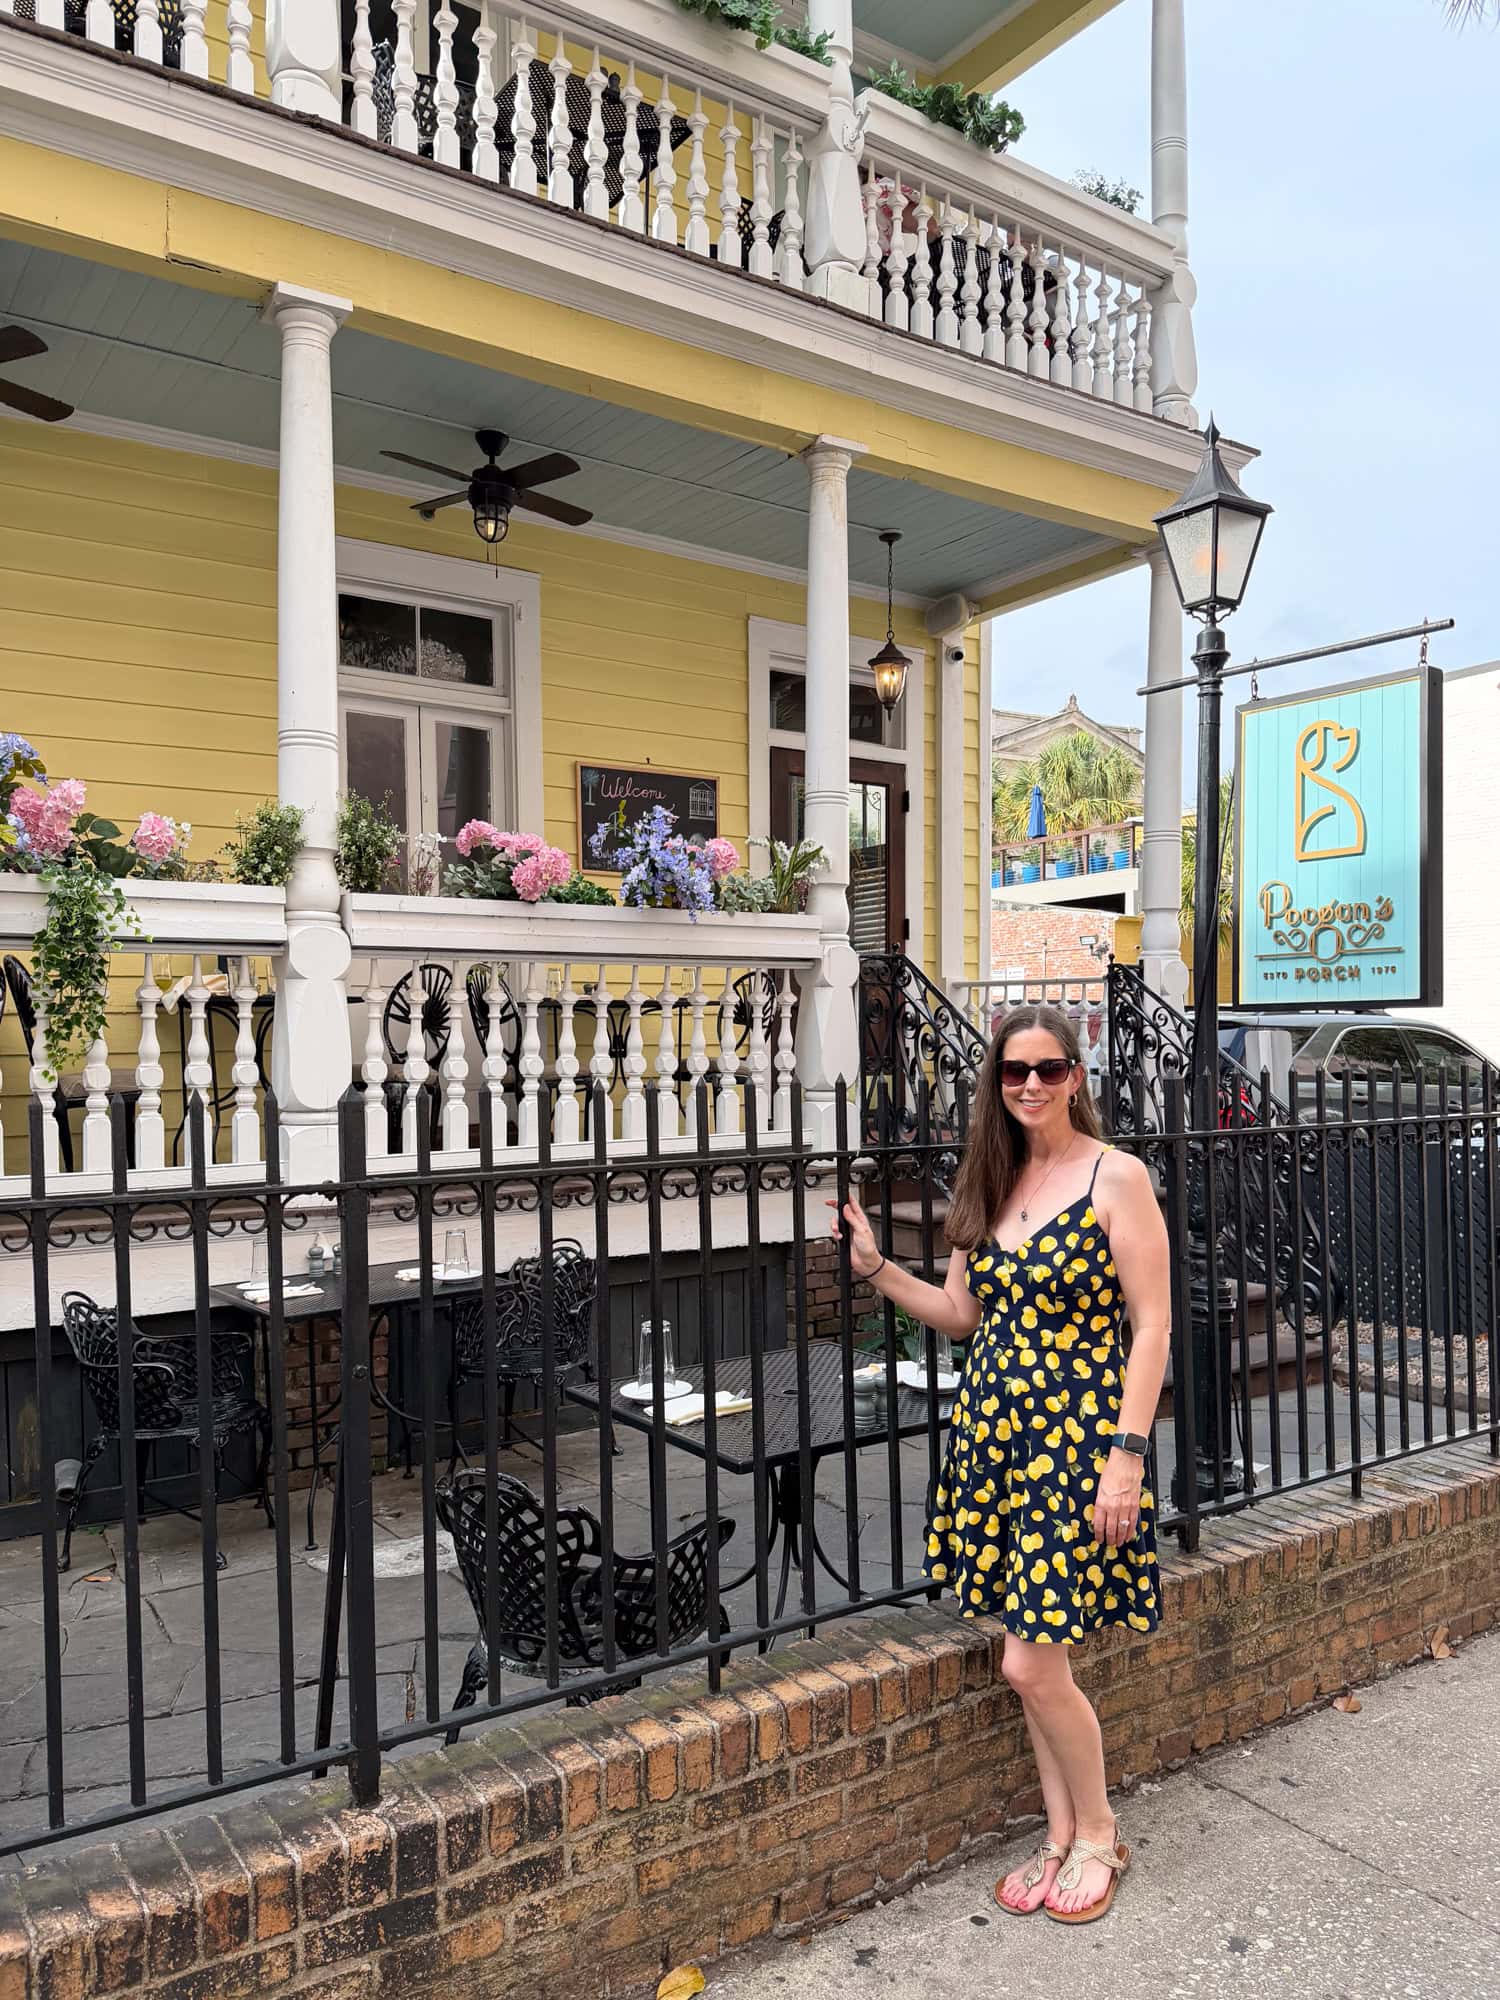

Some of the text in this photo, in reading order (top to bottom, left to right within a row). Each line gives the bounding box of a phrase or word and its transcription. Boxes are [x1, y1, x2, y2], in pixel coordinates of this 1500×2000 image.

[600, 773, 667, 800] Welcome
[1258, 880, 1395, 937] Poogan's
[1294, 965, 1361, 983] PORCH
